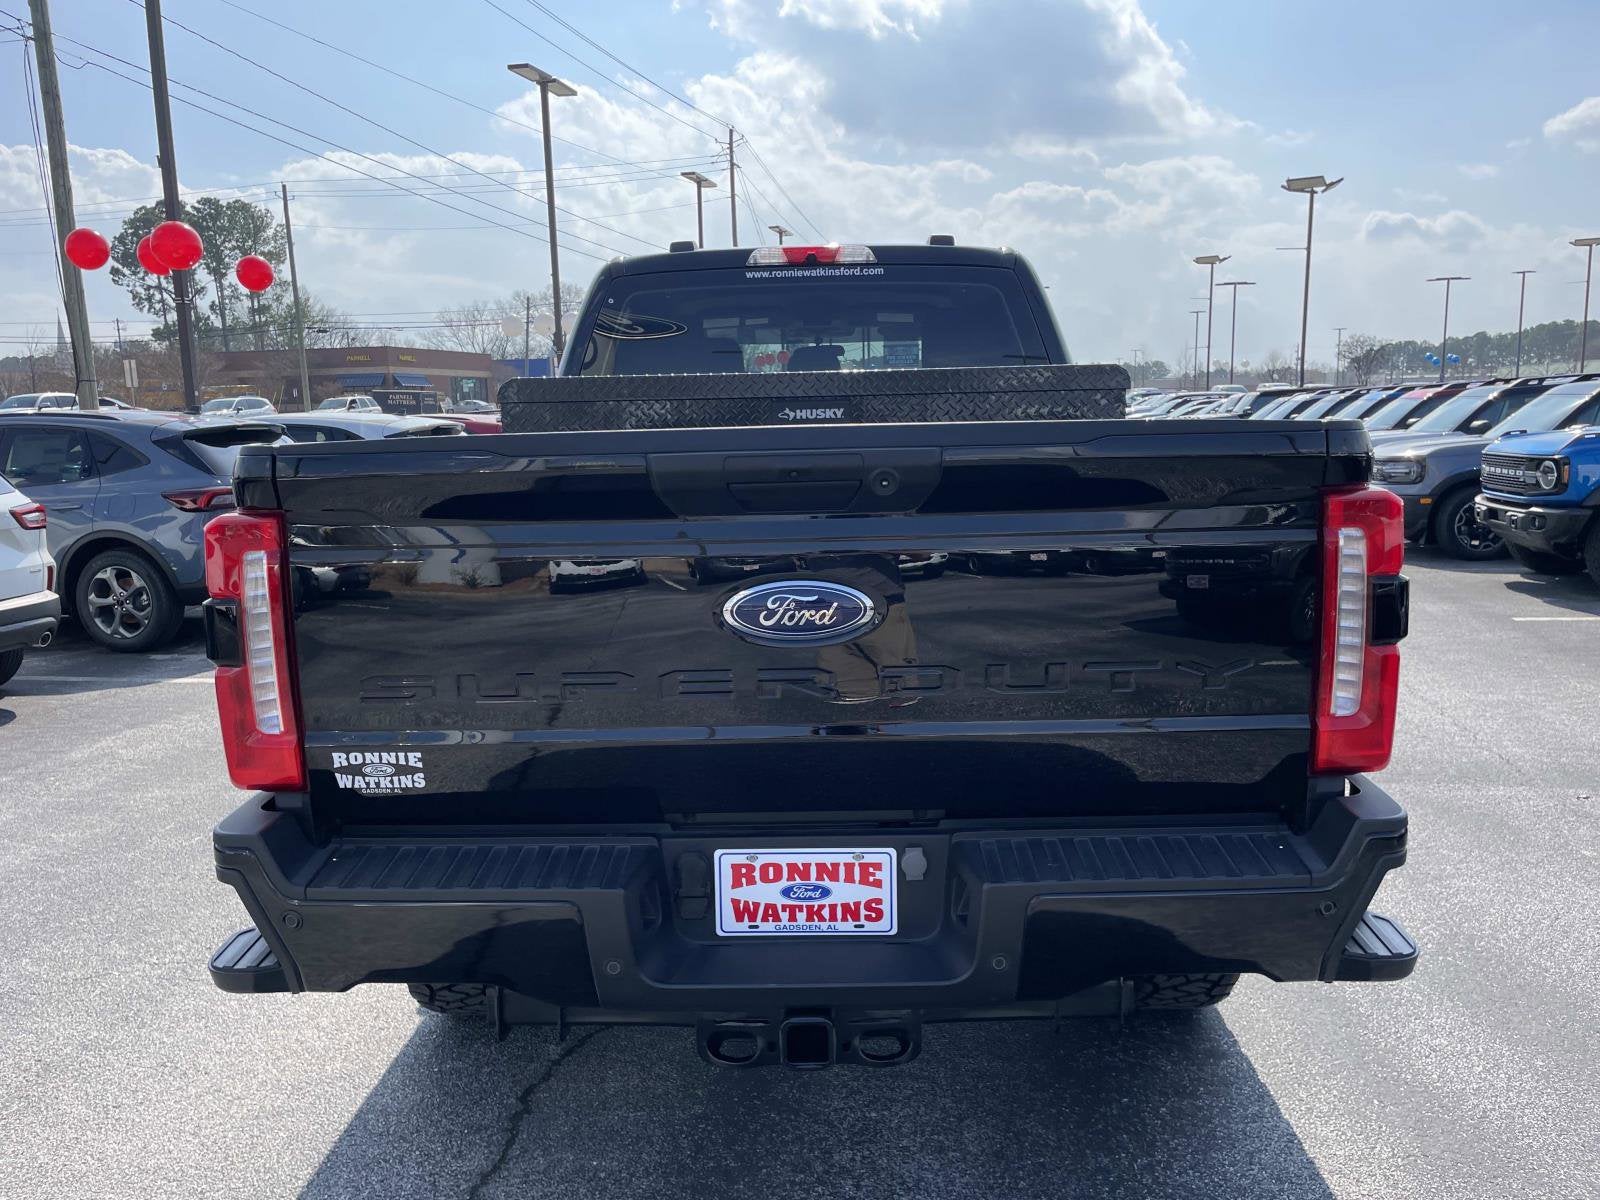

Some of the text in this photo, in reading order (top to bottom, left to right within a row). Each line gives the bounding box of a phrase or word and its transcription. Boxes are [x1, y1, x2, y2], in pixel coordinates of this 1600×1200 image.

[745, 266, 884, 279] www.ronniewatkinsford.com
[795, 407, 844, 419] HUSKY
[1485, 466, 1523, 476] BRONCO
[759, 594, 838, 626] Ford
[359, 660, 1256, 704] SUPER DUTY
[332, 752, 423, 768] RONNIE
[369, 766, 388, 774] Ford
[335, 773, 426, 789] WATKINS
[731, 862, 883, 890] RONNIE
[789, 885, 822, 899] Ford
[731, 897, 884, 923] WATKINS
[774, 924, 824, 932] GADSDEN,
